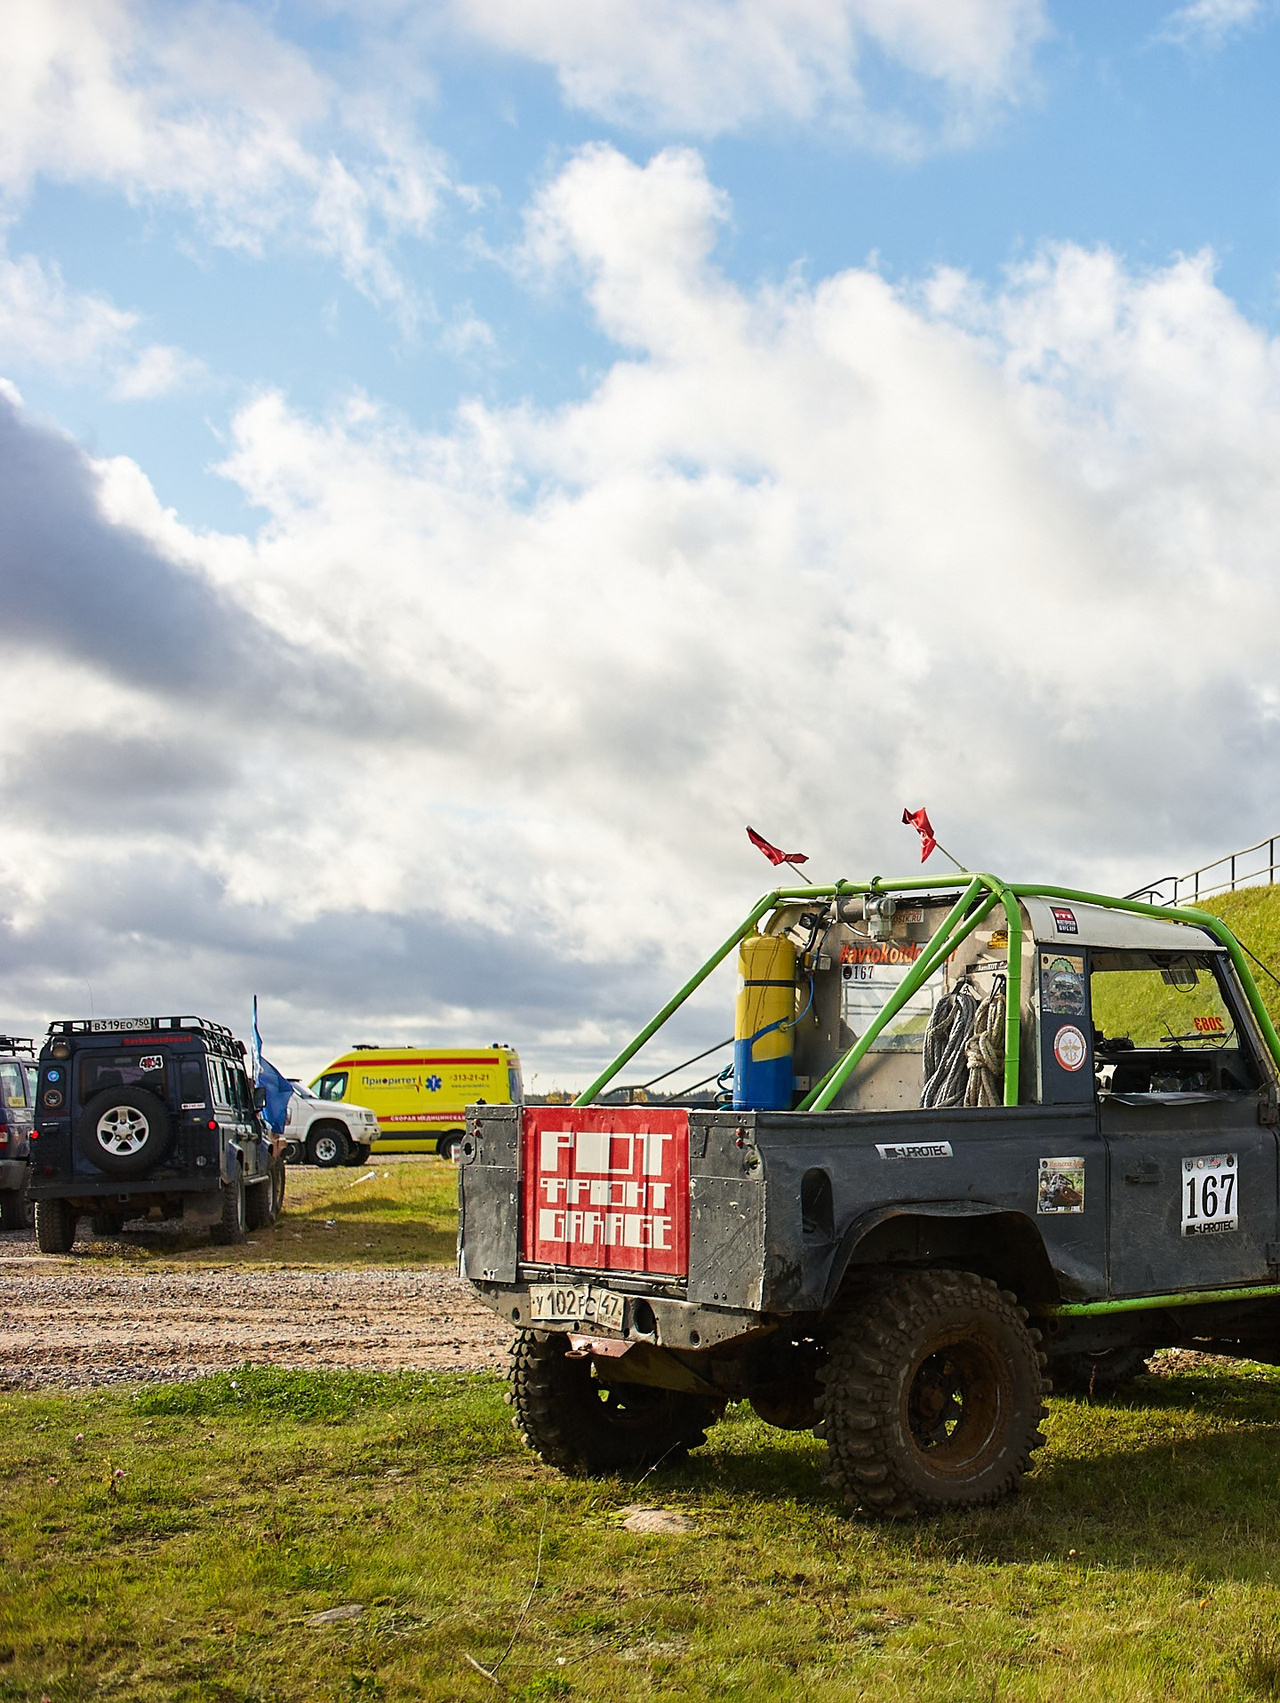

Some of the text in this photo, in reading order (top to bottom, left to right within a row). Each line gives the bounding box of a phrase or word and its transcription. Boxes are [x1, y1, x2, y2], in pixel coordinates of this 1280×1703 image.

[854, 966, 874, 979] 167
[134, 1018, 149, 1027] 750
[361, 1076, 417, 1086] Приоритет
[894, 1146, 947, 1157] SUPROTEC
[540, 1177, 672, 1210] ФРОНТ
[1186, 1174, 1235, 1220] 167
[539, 1208, 672, 1250] GARAGE
[1194, 1220, 1234, 1234] SUPROTEC
[601, 1294, 619, 1317] 47
